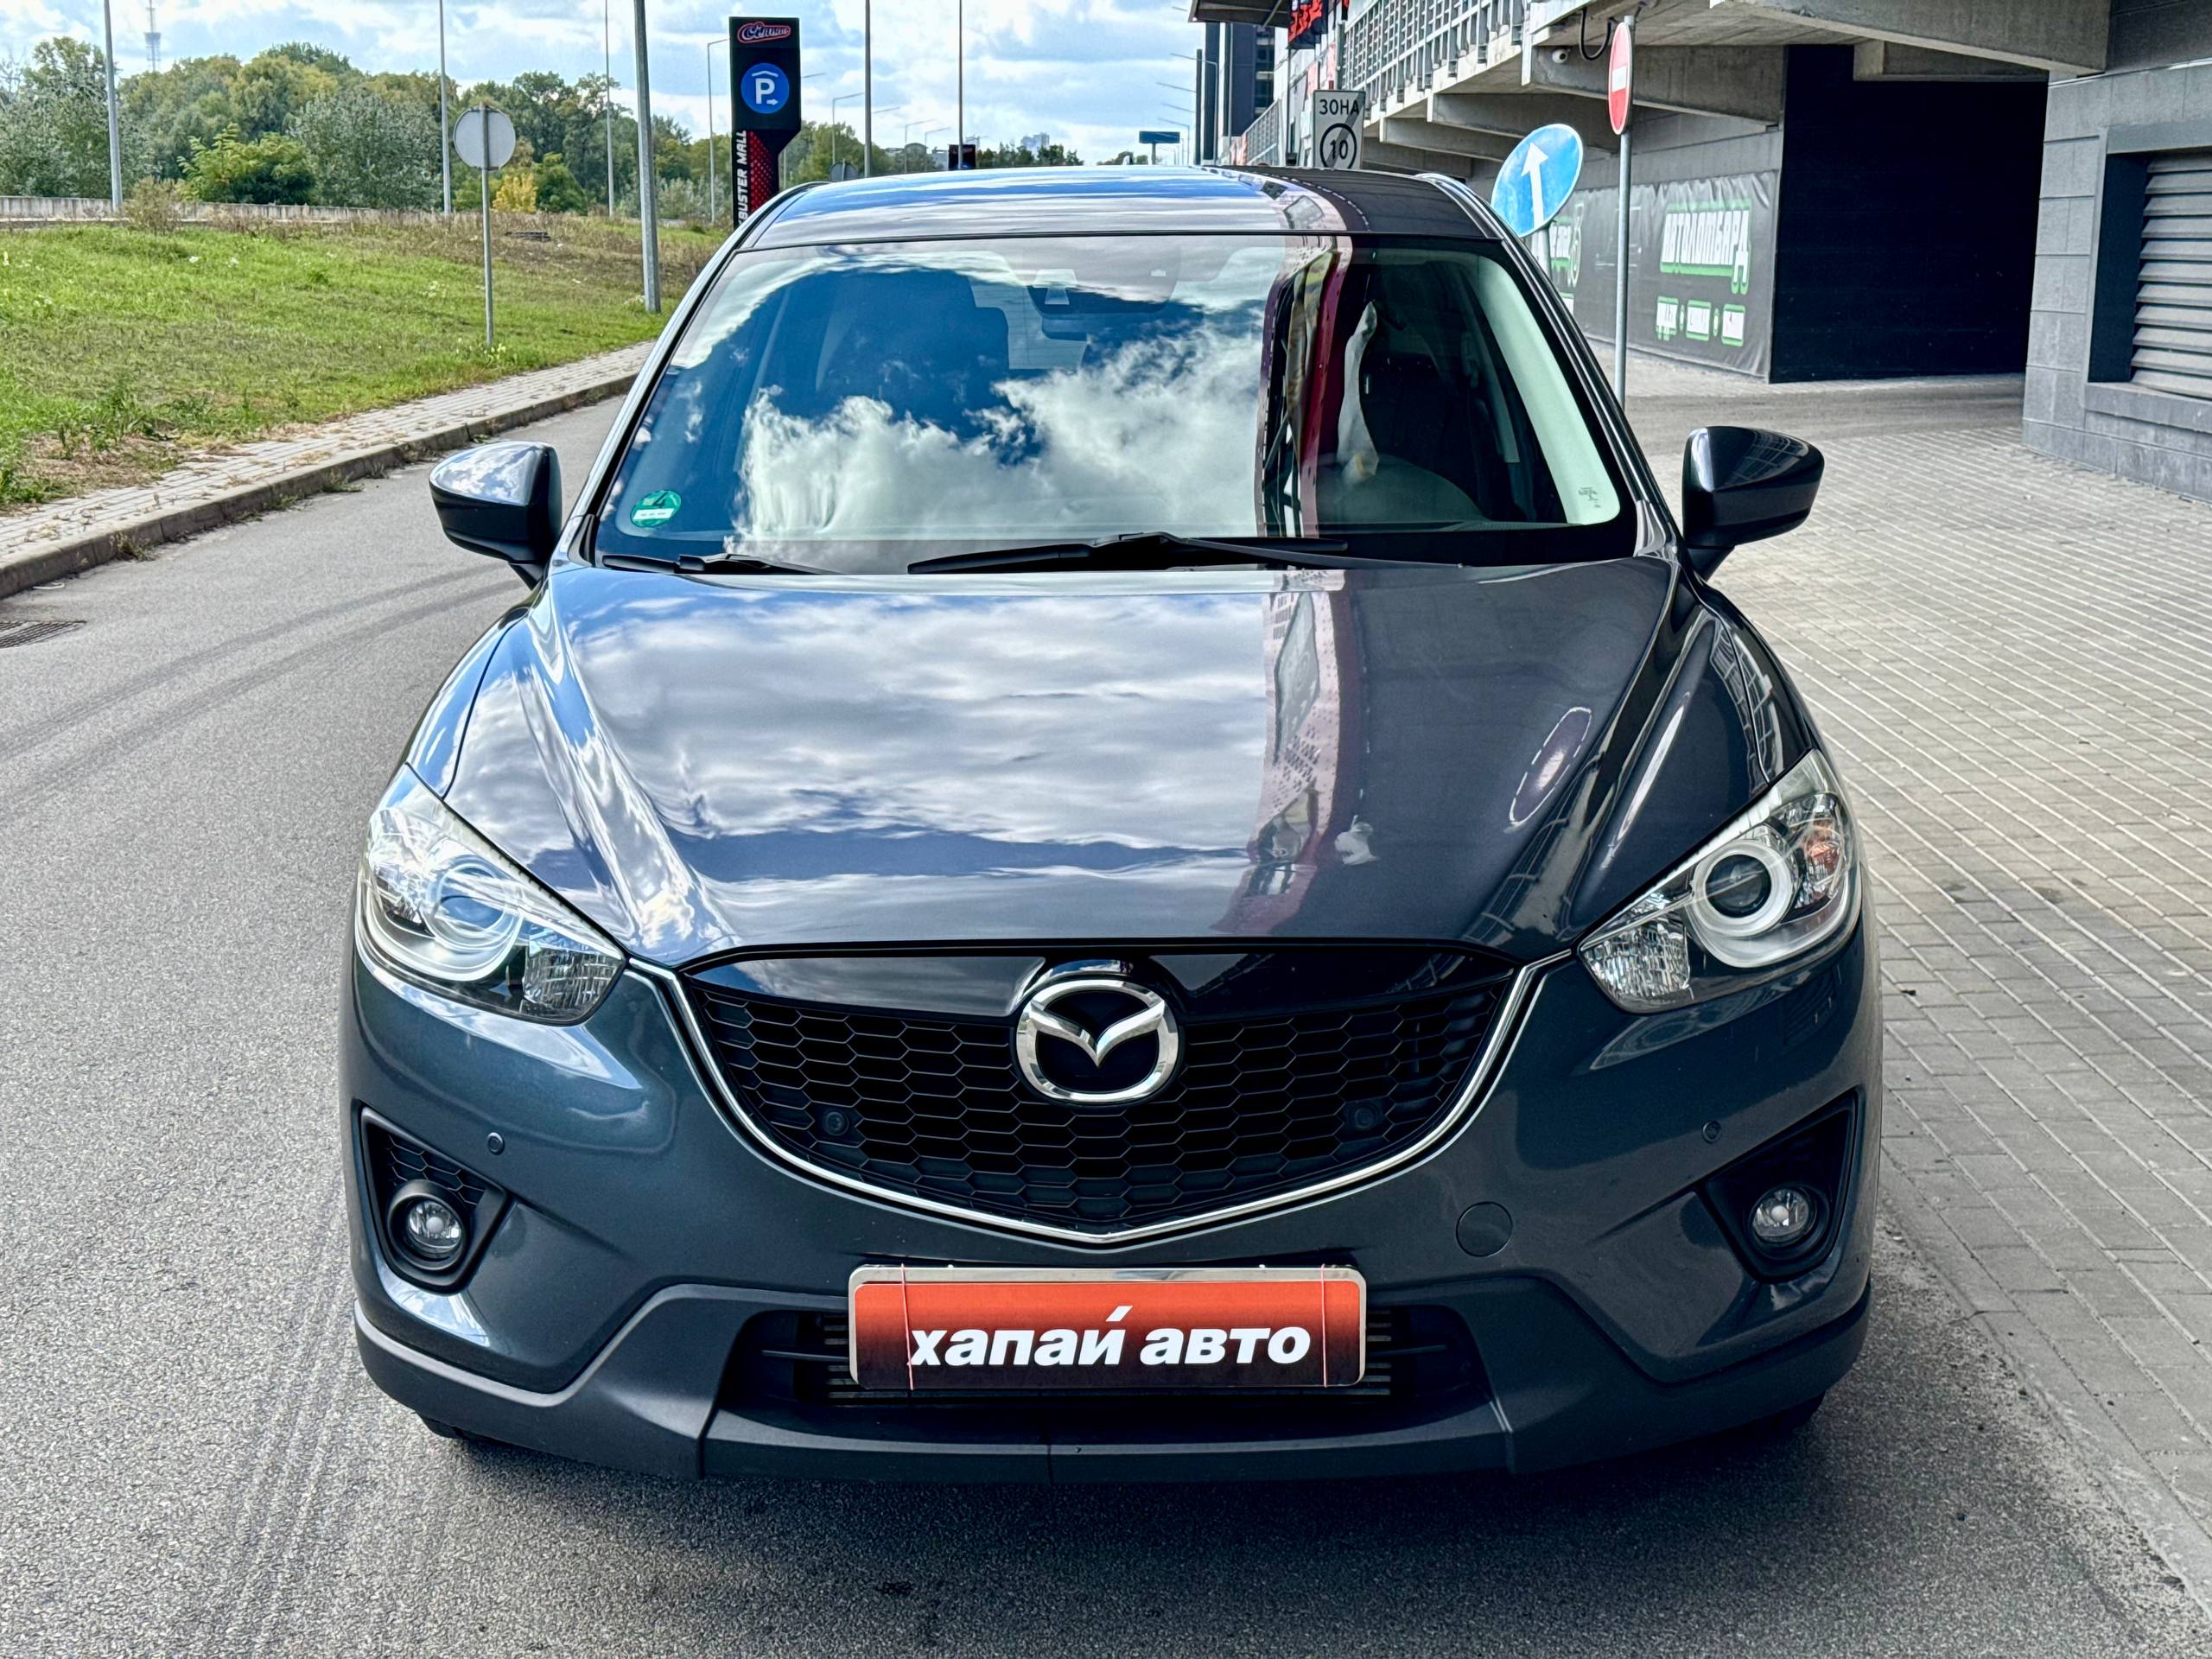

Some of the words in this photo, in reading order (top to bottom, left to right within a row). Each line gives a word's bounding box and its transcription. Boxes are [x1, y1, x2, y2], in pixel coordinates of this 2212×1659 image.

[755, 78, 776, 105] P
[1319, 99, 1360, 115] ЗОНА
[736, 130, 747, 165] MALL
[1330, 139, 1349, 160] 10
[737, 168, 748, 225] BUSTER
[1140, 1326, 1312, 1365] авто
